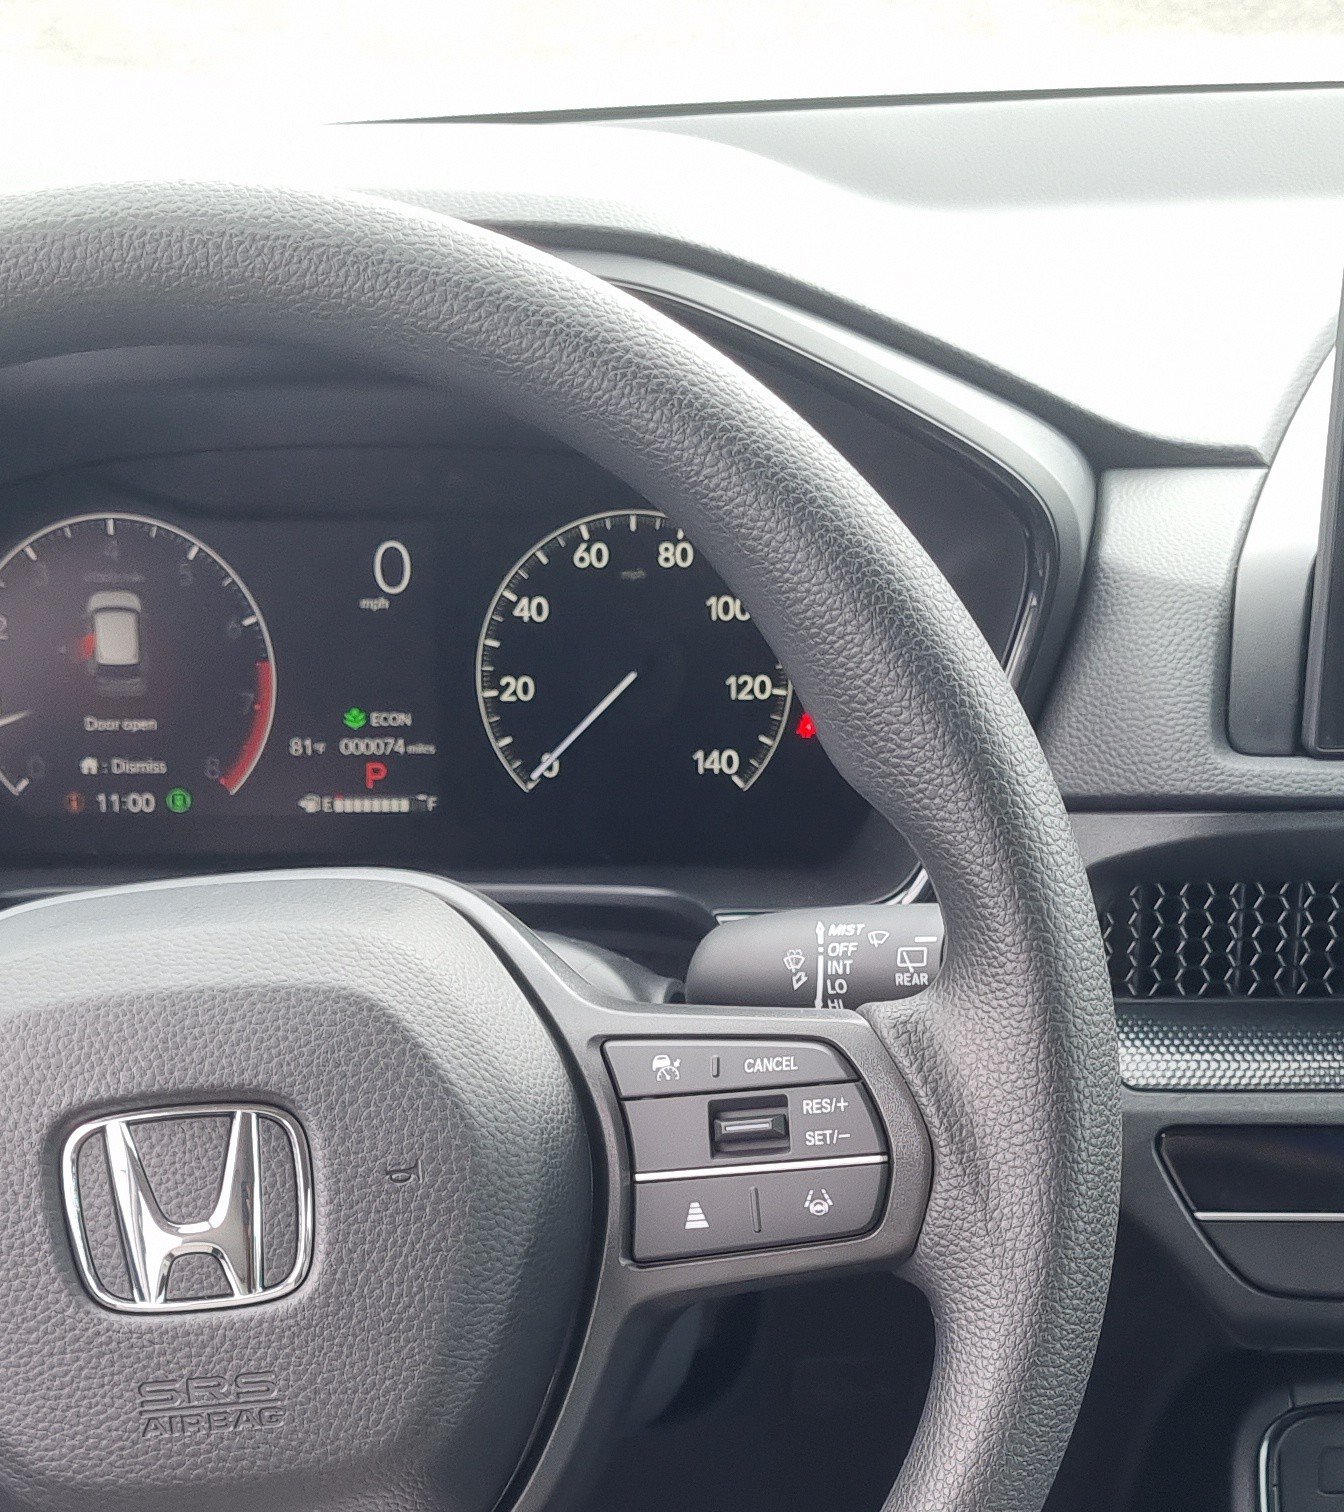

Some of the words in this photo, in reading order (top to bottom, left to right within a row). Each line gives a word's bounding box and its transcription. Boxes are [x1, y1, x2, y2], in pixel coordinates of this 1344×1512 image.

[572, 542, 610, 569] 60
[657, 541, 694, 569] 80
[373, 540, 412, 595] 0
[512, 596, 550, 623] 40
[499, 676, 536, 702] 20
[725, 674, 773, 701] 120
[369, 711, 413, 727] ECON
[338, 736, 406, 756] 000074
[111, 757, 168, 774] Dismiss
[537, 752, 560, 779] 0
[692, 749, 740, 776] 140
[365, 761, 389, 789] P
[96, 792, 156, 814] 11:00
[828, 923, 866, 937] MIST
[827, 942, 858, 957] OFF
[827, 960, 853, 975] INT
[895, 972, 929, 986] REAR
[826, 978, 848, 994] LO
[744, 1055, 799, 1073] CANCEL
[802, 1096, 850, 1115] RES/+
[137, 1370, 279, 1408] SRS
[141, 1405, 288, 1439] AIRBAG
